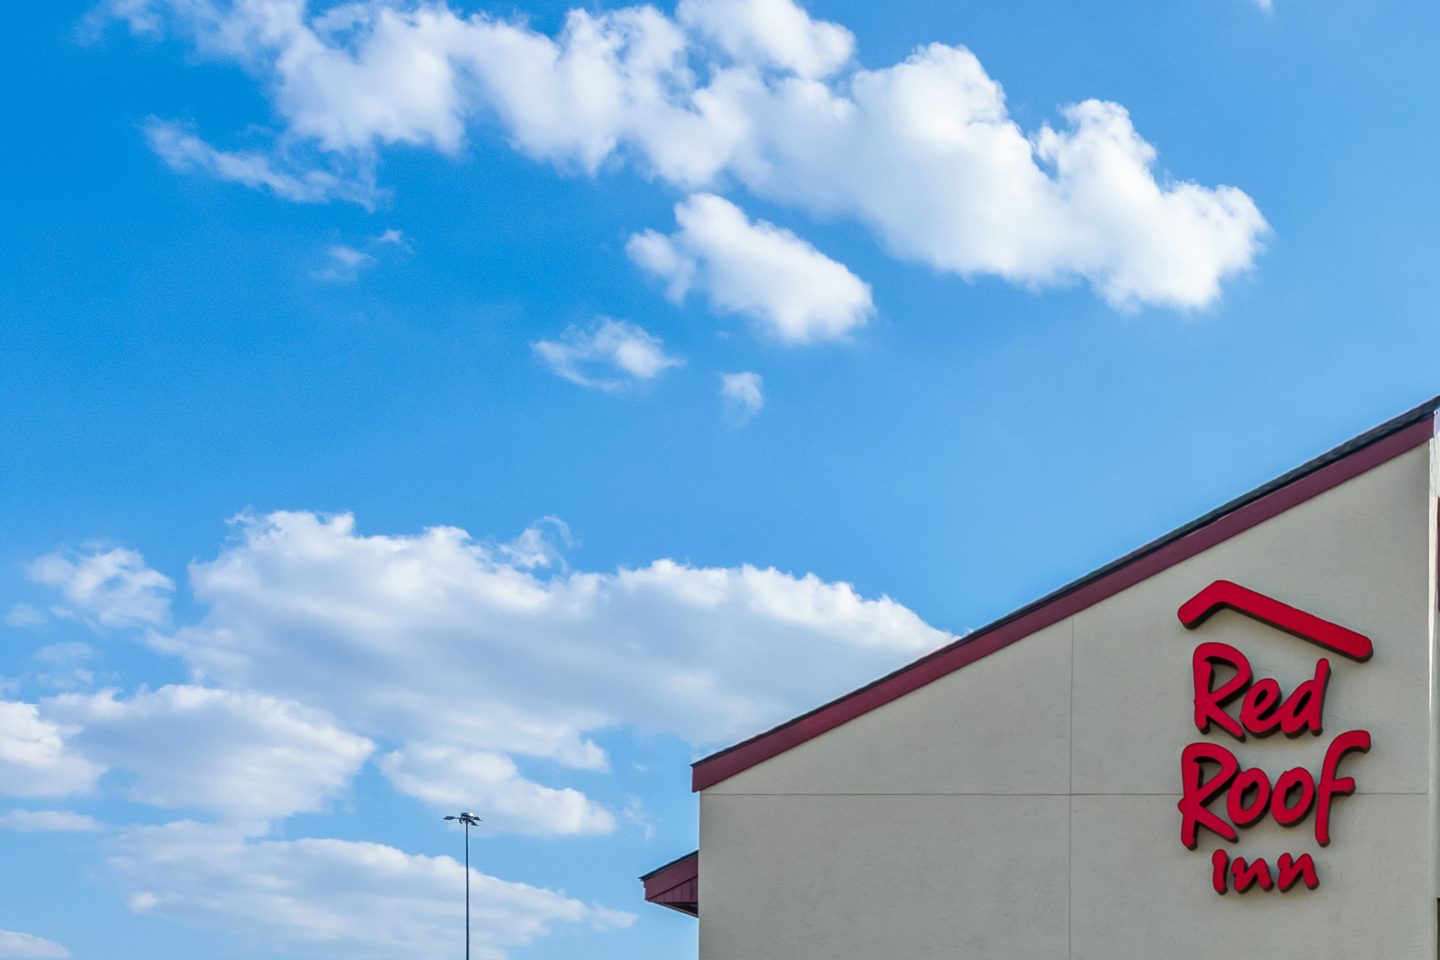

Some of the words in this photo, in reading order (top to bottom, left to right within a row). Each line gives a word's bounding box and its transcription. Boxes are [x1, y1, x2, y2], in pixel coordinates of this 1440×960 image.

[1193, 642, 1330, 740] Red
[1178, 730, 1371, 849] Roof
[1212, 849, 1319, 894] Inn
